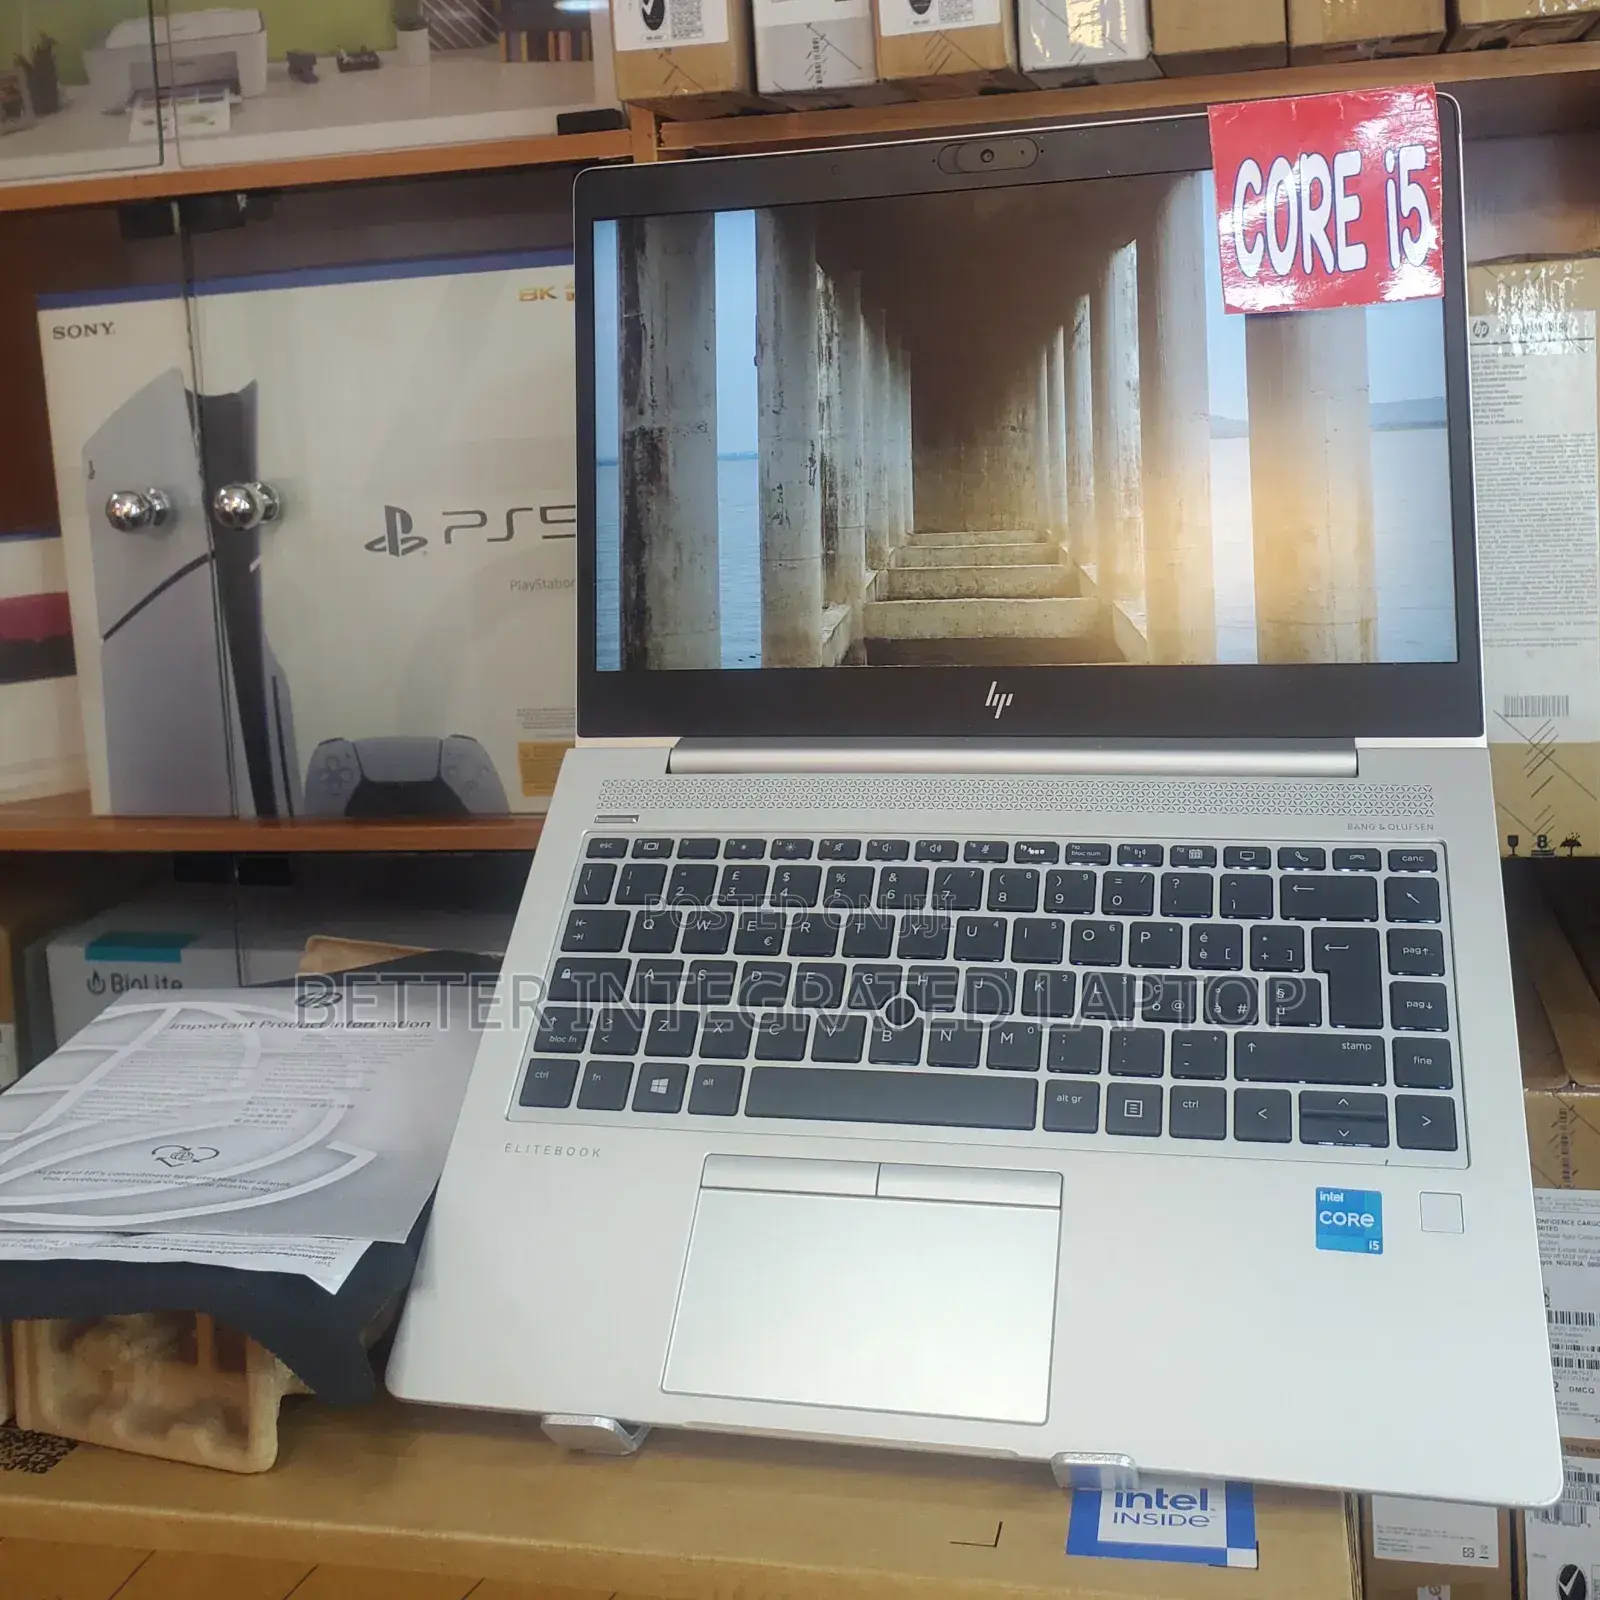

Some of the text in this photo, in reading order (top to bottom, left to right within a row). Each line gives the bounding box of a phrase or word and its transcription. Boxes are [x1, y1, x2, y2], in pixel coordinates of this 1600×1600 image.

[1232, 145, 1432, 278] CORE i5
[519, 286, 557, 302] 8K
[53, 321, 114, 340] SONY
[442, 505, 576, 545] PS5
[1348, 823, 1376, 832] BANG
[1388, 823, 1435, 831] OLUFSEN
[731, 870, 740, 880] £
[782, 871, 791, 883] $
[835, 872, 846, 883] %
[888, 872, 898, 883] &
[1025, 871, 1032, 879] 8
[1082, 873, 1089, 881] 9
[1172, 878, 1180, 888] ?
[625, 886, 631, 896] 1
[675, 886, 685, 896] 2
[727, 886, 736, 897] 3
[779, 887, 789, 897] 4
[833, 889, 842, 899] 5
[887, 889, 896, 900] 6
[941, 890, 950, 900] 7
[998, 892, 1007, 902] 8
[1055, 893, 1064, 903] 9
[643, 919, 655, 930] Q
[696, 920, 712, 931] W
[747, 920, 758, 932] E
[800, 922, 811, 933] R
[854, 922, 864, 934] T
[911, 924, 922, 935] Y
[1109, 924, 1116, 932] 6
[966, 925, 978, 937] U
[763, 936, 773, 946] €
[1140, 931, 1151, 943] P
[643, 968, 655, 980] A
[697, 969, 707, 981] S
[751, 970, 762, 982] D
[804, 971, 816, 983] F
[862, 973, 874, 985] G
[1062, 974, 1068, 982] 2
[917, 974, 928, 986] H
[974, 977, 984, 989] J
[1034, 979, 1045, 992] K
[1121, 975, 1128, 985] 3
[1094, 982, 1103, 994] L
[1171, 1000, 1185, 1012] @
[1237, 1003, 1248, 1015] #
[169, 1020, 431, 1031] Important Product Information
[657, 1020, 670, 1032] Z
[712, 1021, 724, 1034] X
[768, 1023, 781, 1036] C
[826, 1025, 837, 1038] V
[881, 1030, 893, 1042] B
[940, 1030, 952, 1042] N
[549, 1035, 577, 1044] bloc fn
[1000, 1032, 1013, 1044] M
[1341, 1041, 1372, 1051] stamp
[1413, 1055, 1433, 1066] fine
[534, 1070, 549, 1079] ctrl
[592, 1073, 601, 1081] fn
[702, 1078, 715, 1087] alt
[1056, 1094, 1083, 1104] alt gr
[1182, 1100, 1199, 1109] ctrl
[504, 1142, 601, 1158] ELITEBOOK
[1320, 1190, 1344, 1203] intel
[1536, 1218, 1575, 1226] ONFIDENCE
[1368, 1240, 1380, 1251] i5
[1569, 1385, 1595, 1394] DMCQ
[1115, 1488, 1209, 1512] intel
